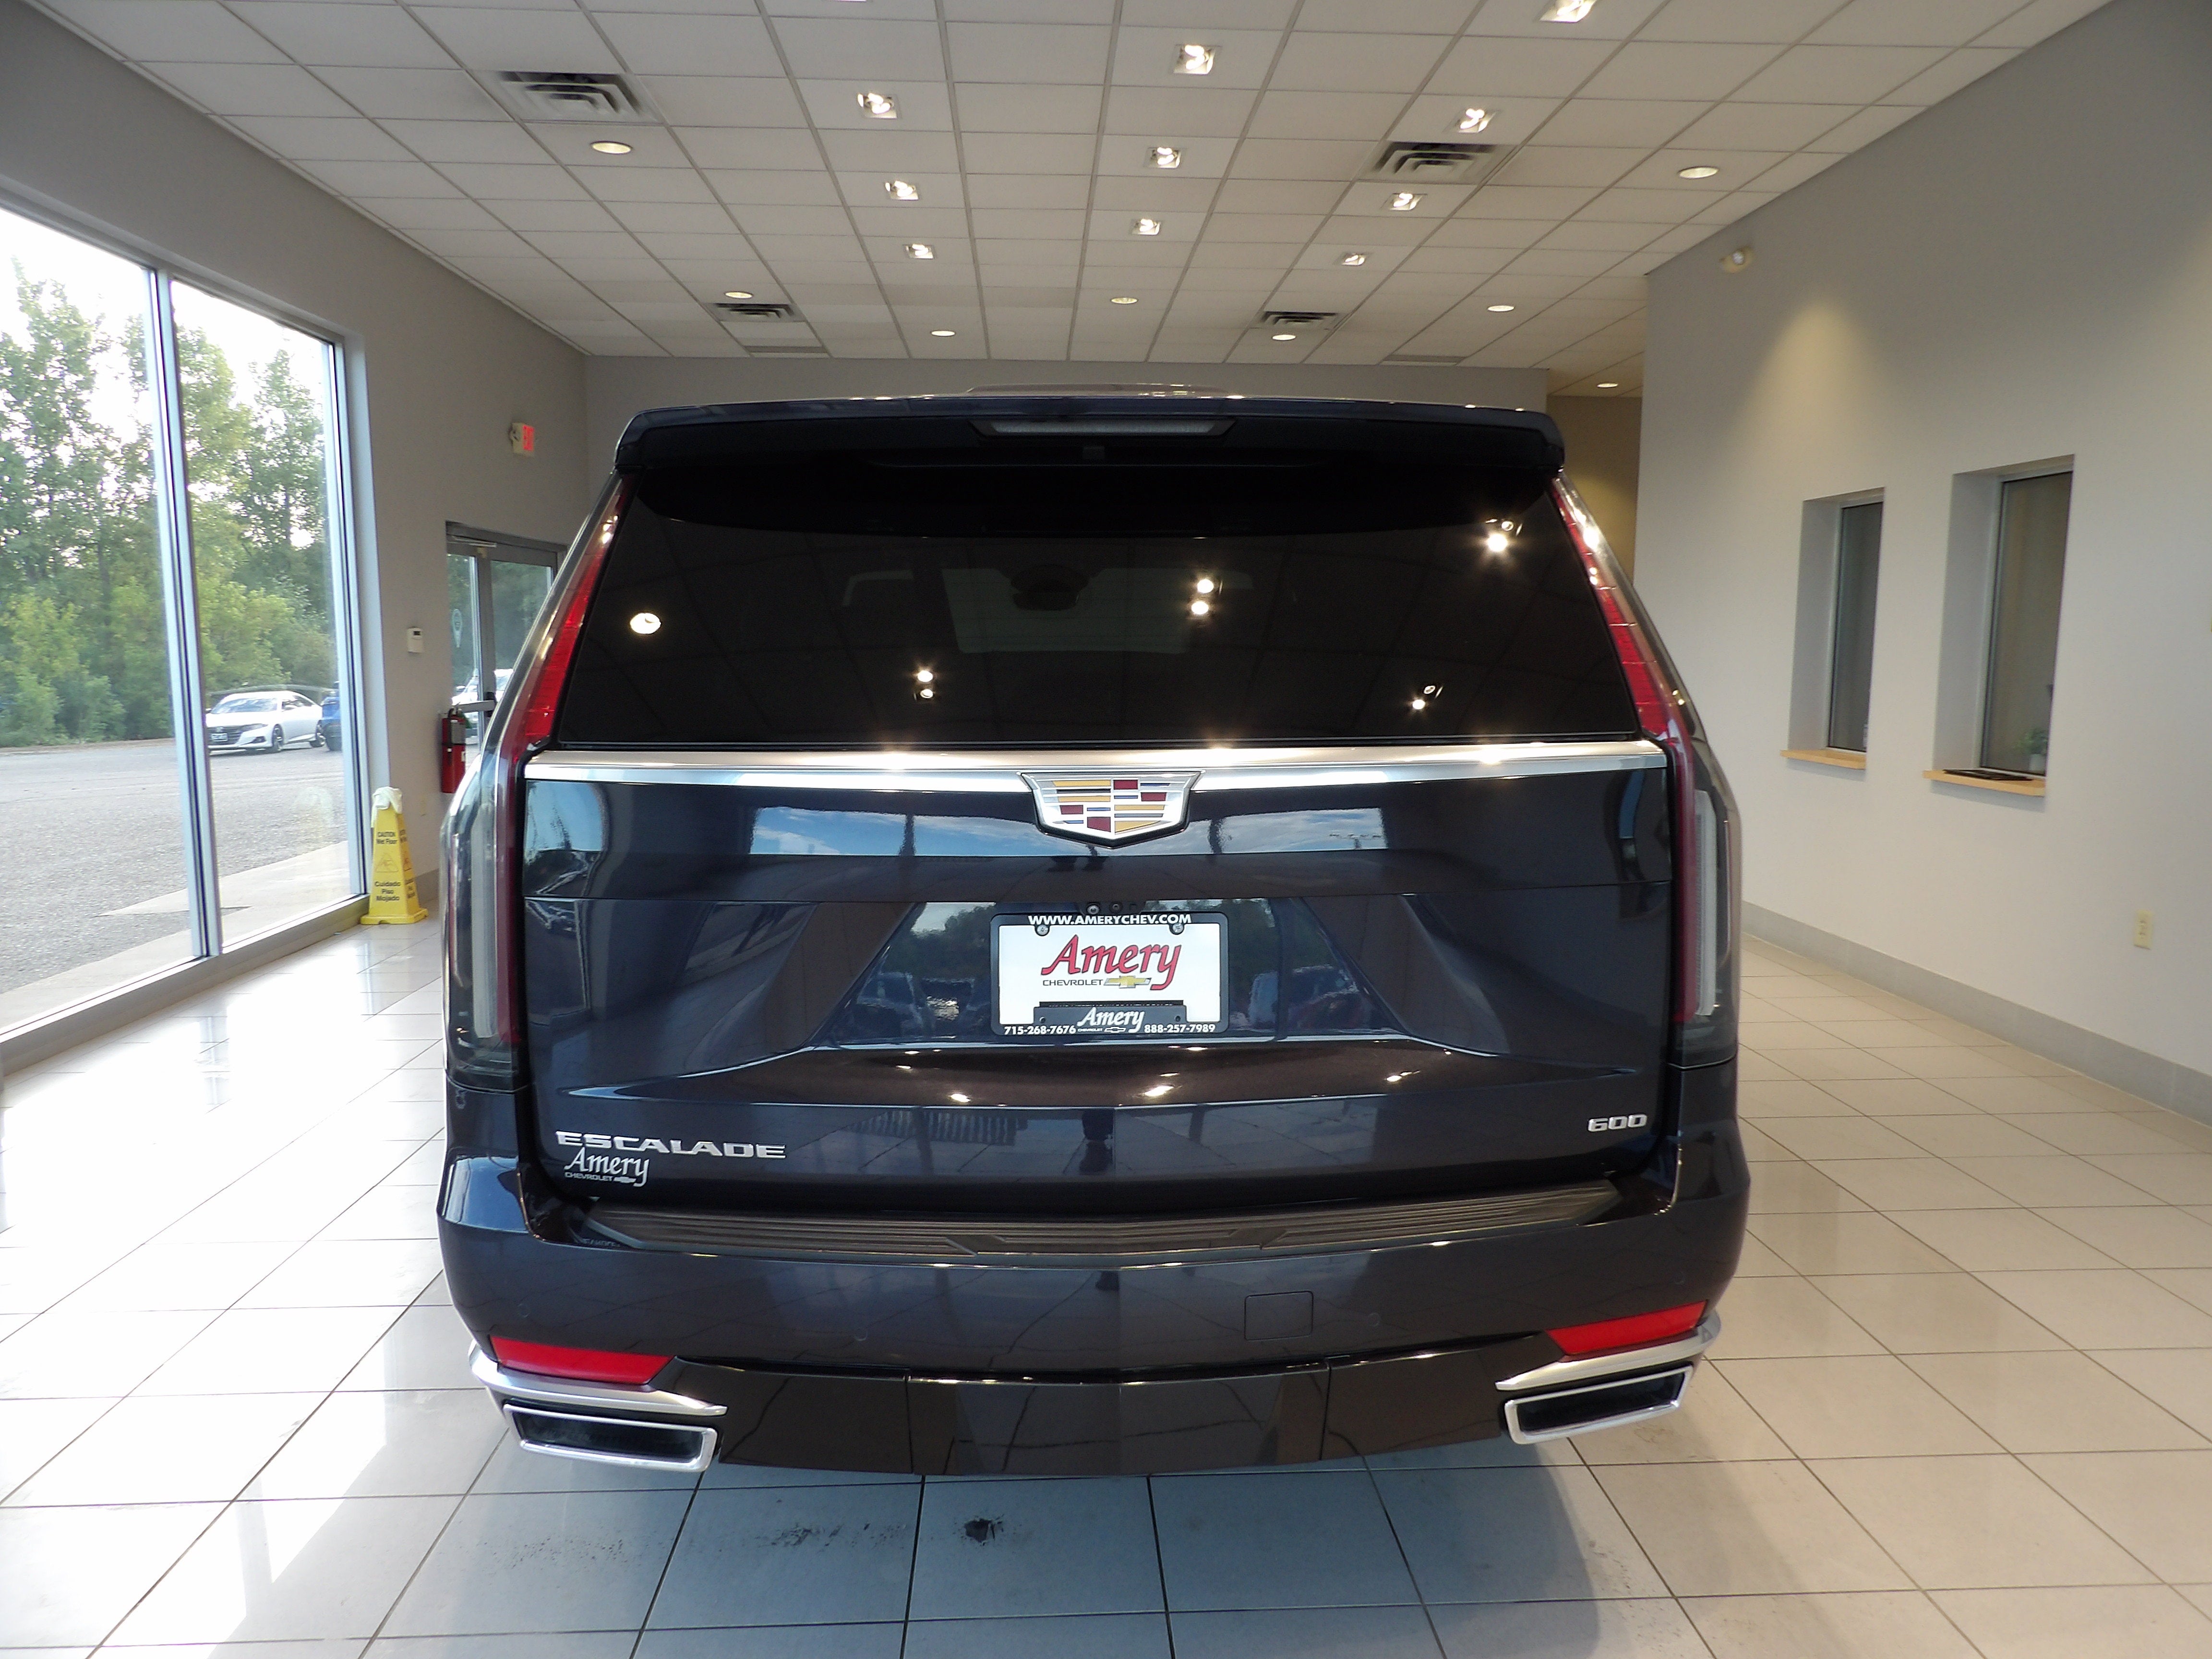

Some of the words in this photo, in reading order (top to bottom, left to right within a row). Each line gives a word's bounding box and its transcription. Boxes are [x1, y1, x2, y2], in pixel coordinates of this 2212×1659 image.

[1028, 914, 1191, 925] WWW.AMERYCHEV.COM
[1040, 934, 1181, 990] Amery
[1077, 1007, 1145, 1033] Amery
[1144, 1024, 1215, 1033] 888-257-7989
[1004, 1025, 1076, 1034] 715-268-7676
[1587, 1114, 1647, 1132] 600
[555, 1130, 786, 1159] ESCALADE
[564, 1147, 650, 1187] Amery
[565, 1171, 613, 1182] CHEVROLET
